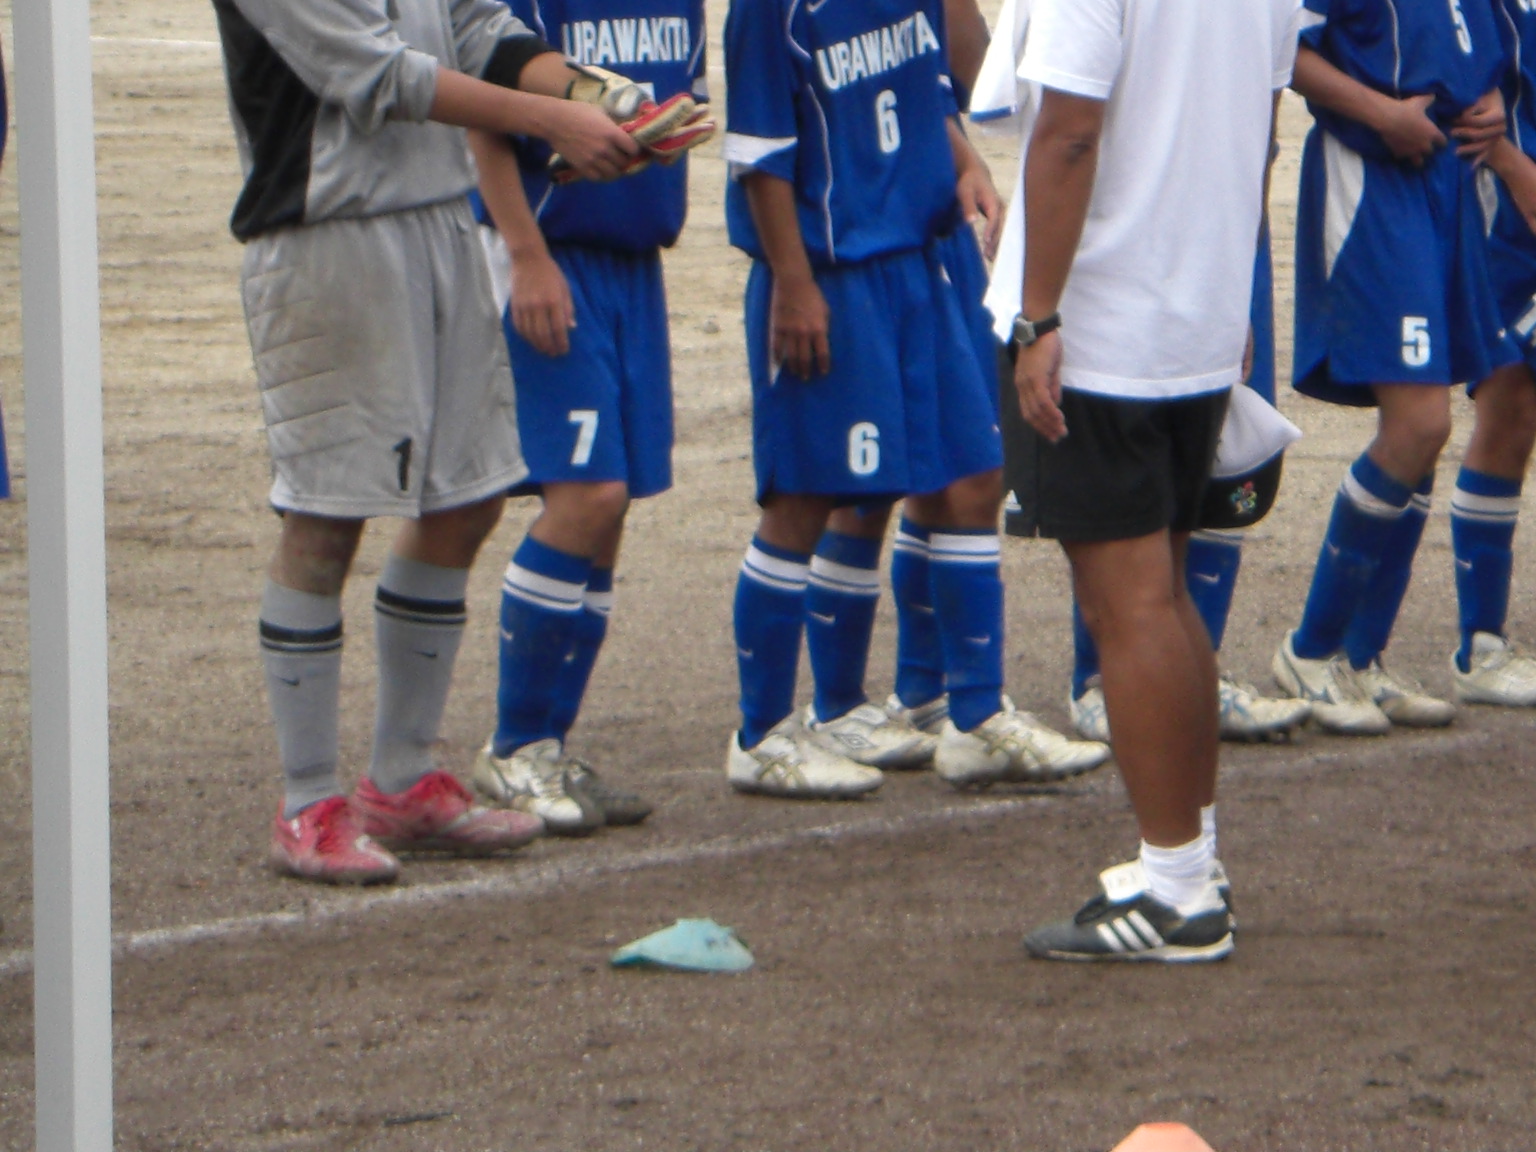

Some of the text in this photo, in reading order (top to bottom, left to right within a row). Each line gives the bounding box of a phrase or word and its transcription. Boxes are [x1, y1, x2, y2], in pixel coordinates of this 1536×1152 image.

[815, 10, 941, 90] URAWAKITA
[875, 89, 901, 154] 6
[1402, 315, 1431, 368] 5
[392, 436, 413, 492] 1
[567, 410, 600, 466] 7
[848, 421, 880, 475] 6
